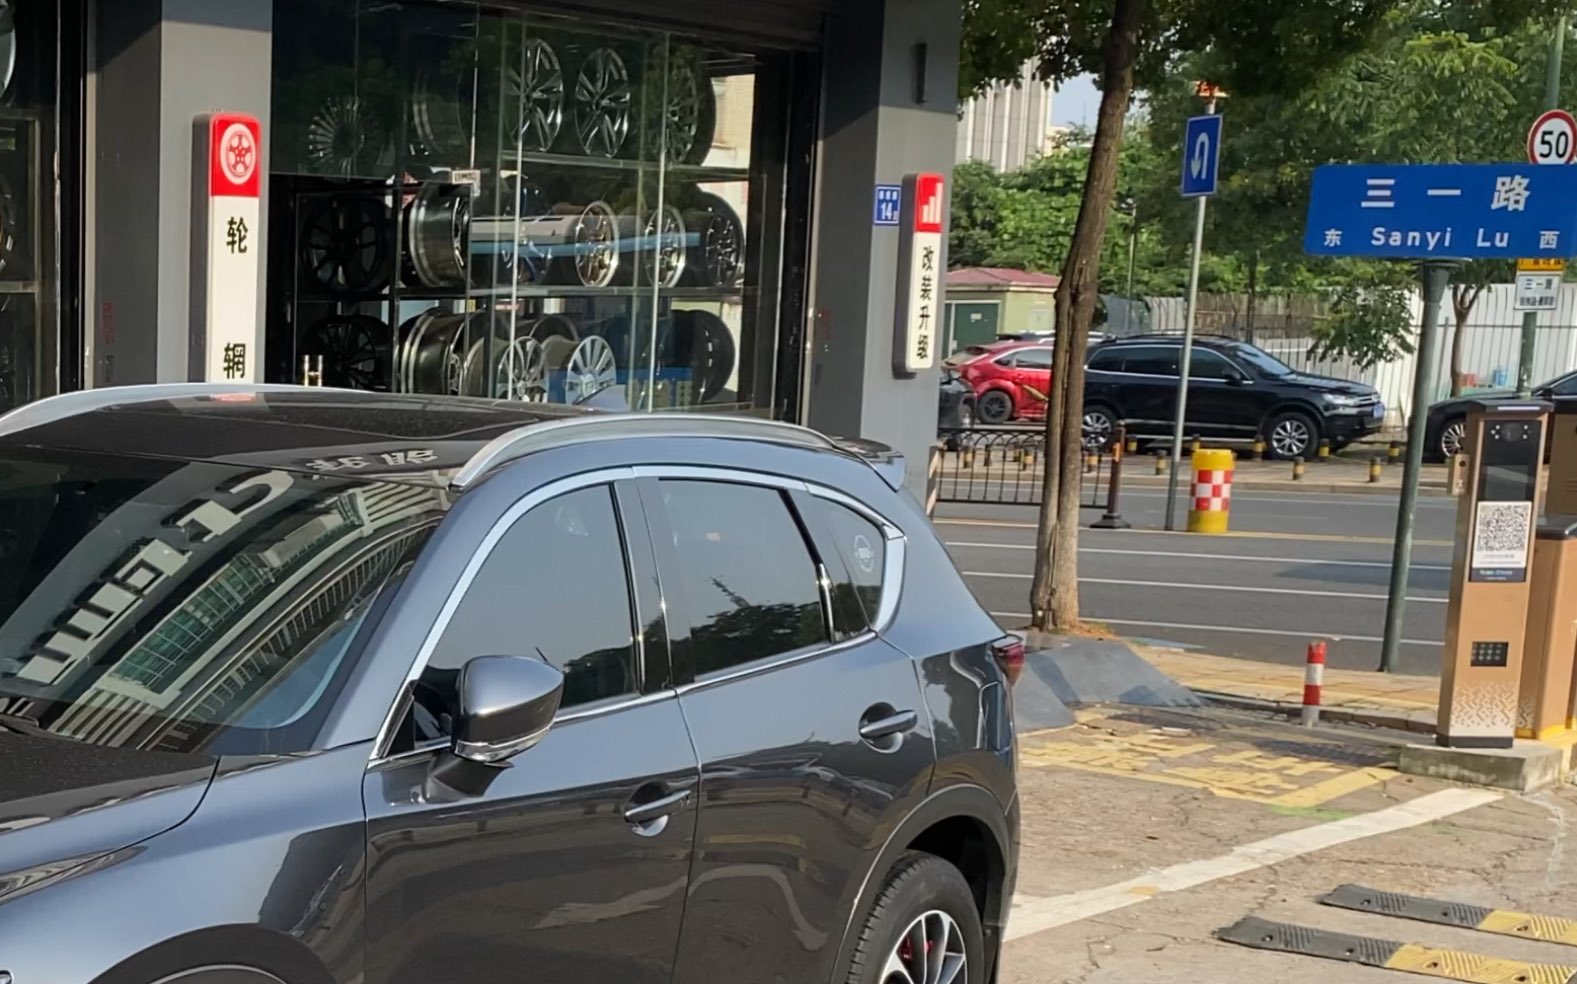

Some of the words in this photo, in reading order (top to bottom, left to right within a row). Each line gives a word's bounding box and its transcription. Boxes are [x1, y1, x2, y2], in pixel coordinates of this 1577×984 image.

[1539, 131, 1569, 158] 50
[1361, 175, 1531, 211] 三一路
[1324, 228, 1342, 248] 东
[1371, 227, 1452, 250] Sanyi
[1476, 228, 1510, 248] Lu
[1539, 231, 1560, 249] 西
[917, 245, 934, 360] 改装升级
